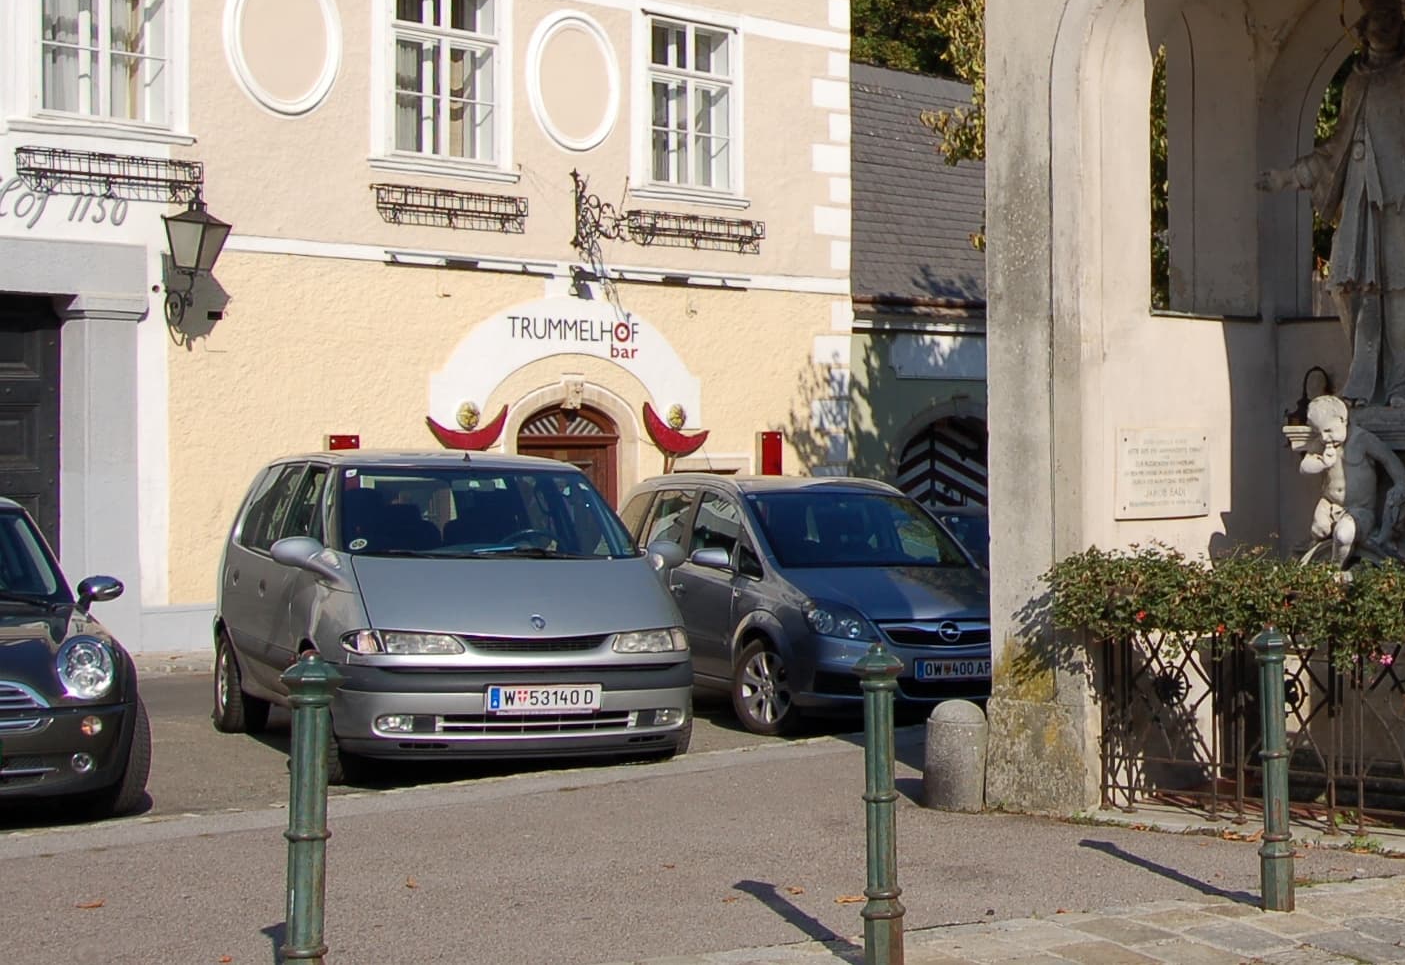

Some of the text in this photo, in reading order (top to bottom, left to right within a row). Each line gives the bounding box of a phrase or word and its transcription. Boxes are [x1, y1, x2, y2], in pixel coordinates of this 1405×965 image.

[507, 315, 640, 344] TRUMMELHOF
[610, 343, 639, 360] bar
[925, 662, 942, 676] OW
[952, 661, 974, 676] 400
[504, 689, 594, 706] W 53140 D
